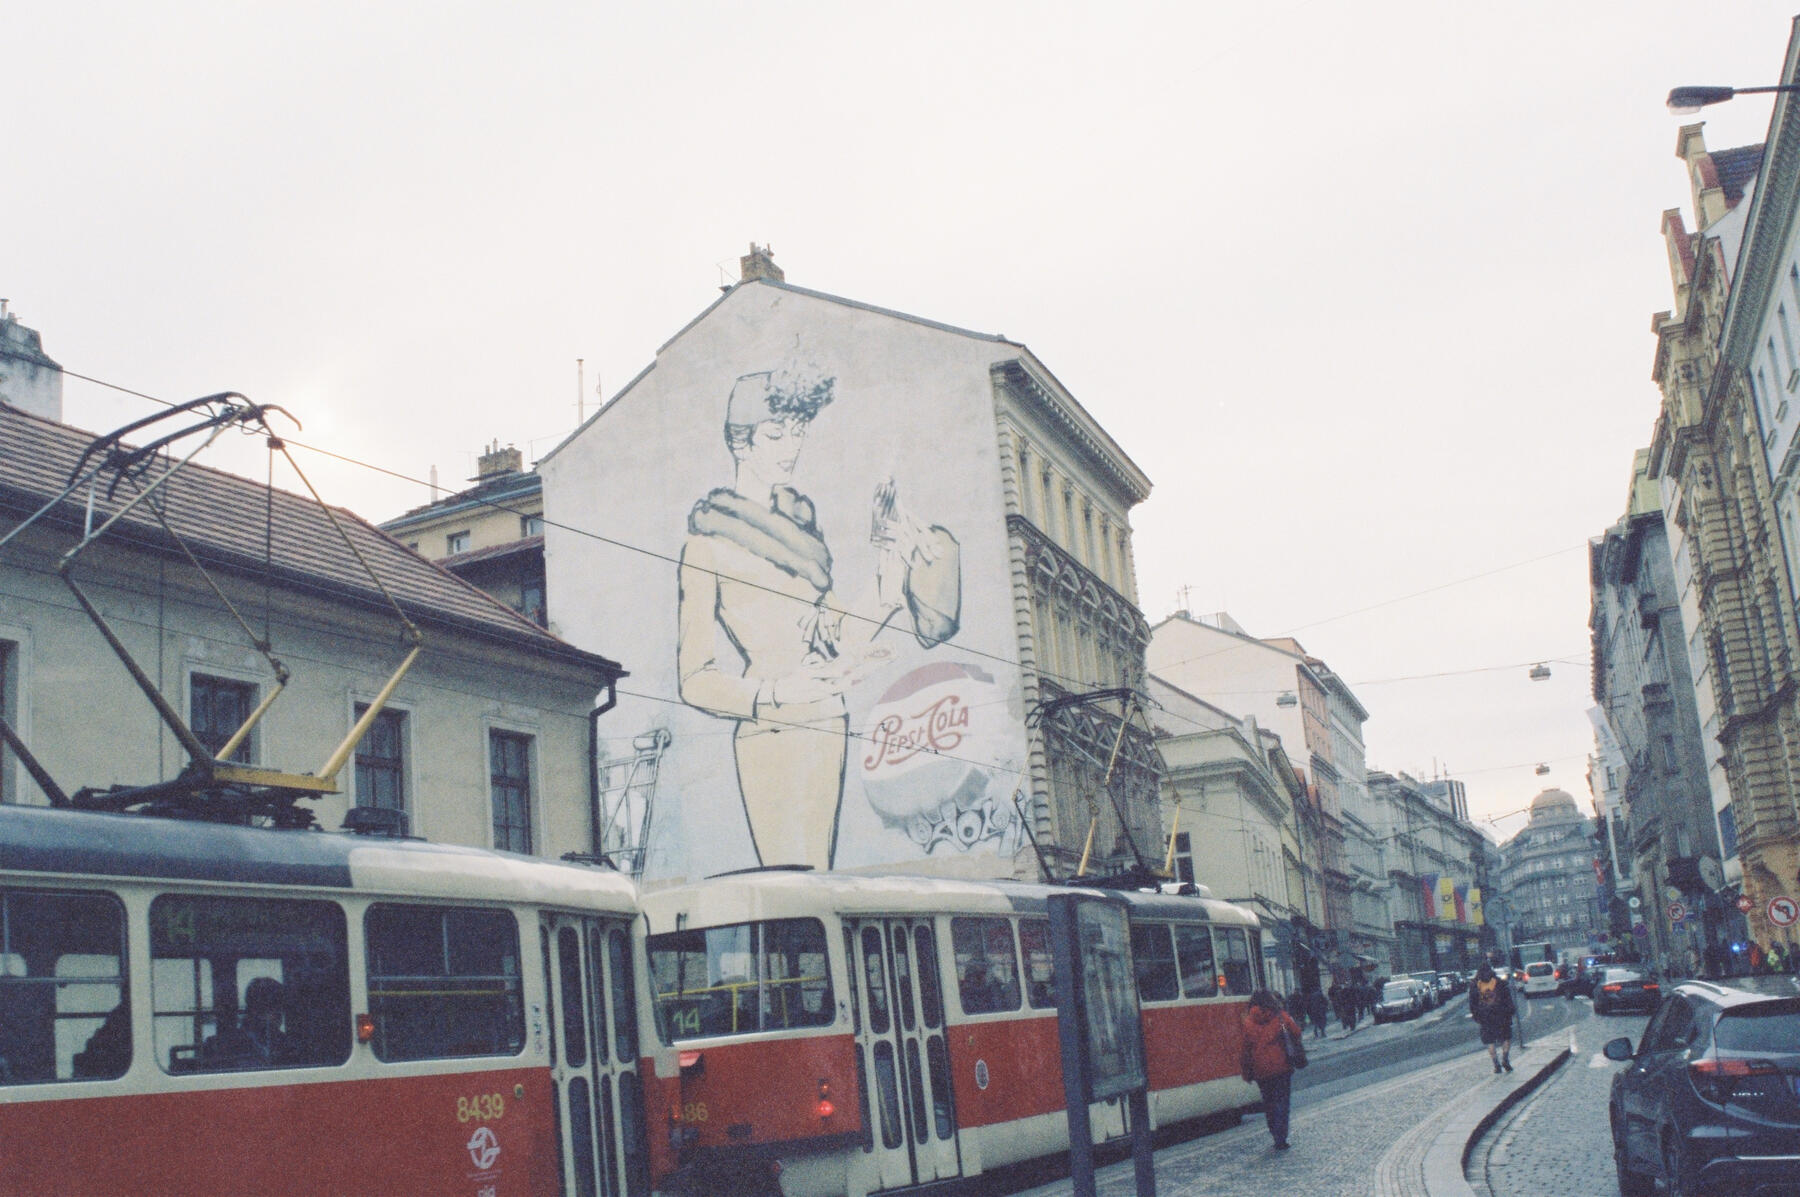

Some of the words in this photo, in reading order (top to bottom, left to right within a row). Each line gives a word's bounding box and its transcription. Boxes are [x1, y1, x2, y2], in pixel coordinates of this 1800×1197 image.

[673, 1007, 700, 1034] 14
[457, 1092, 504, 1123] 8439
[679, 1102, 708, 1121] 86
